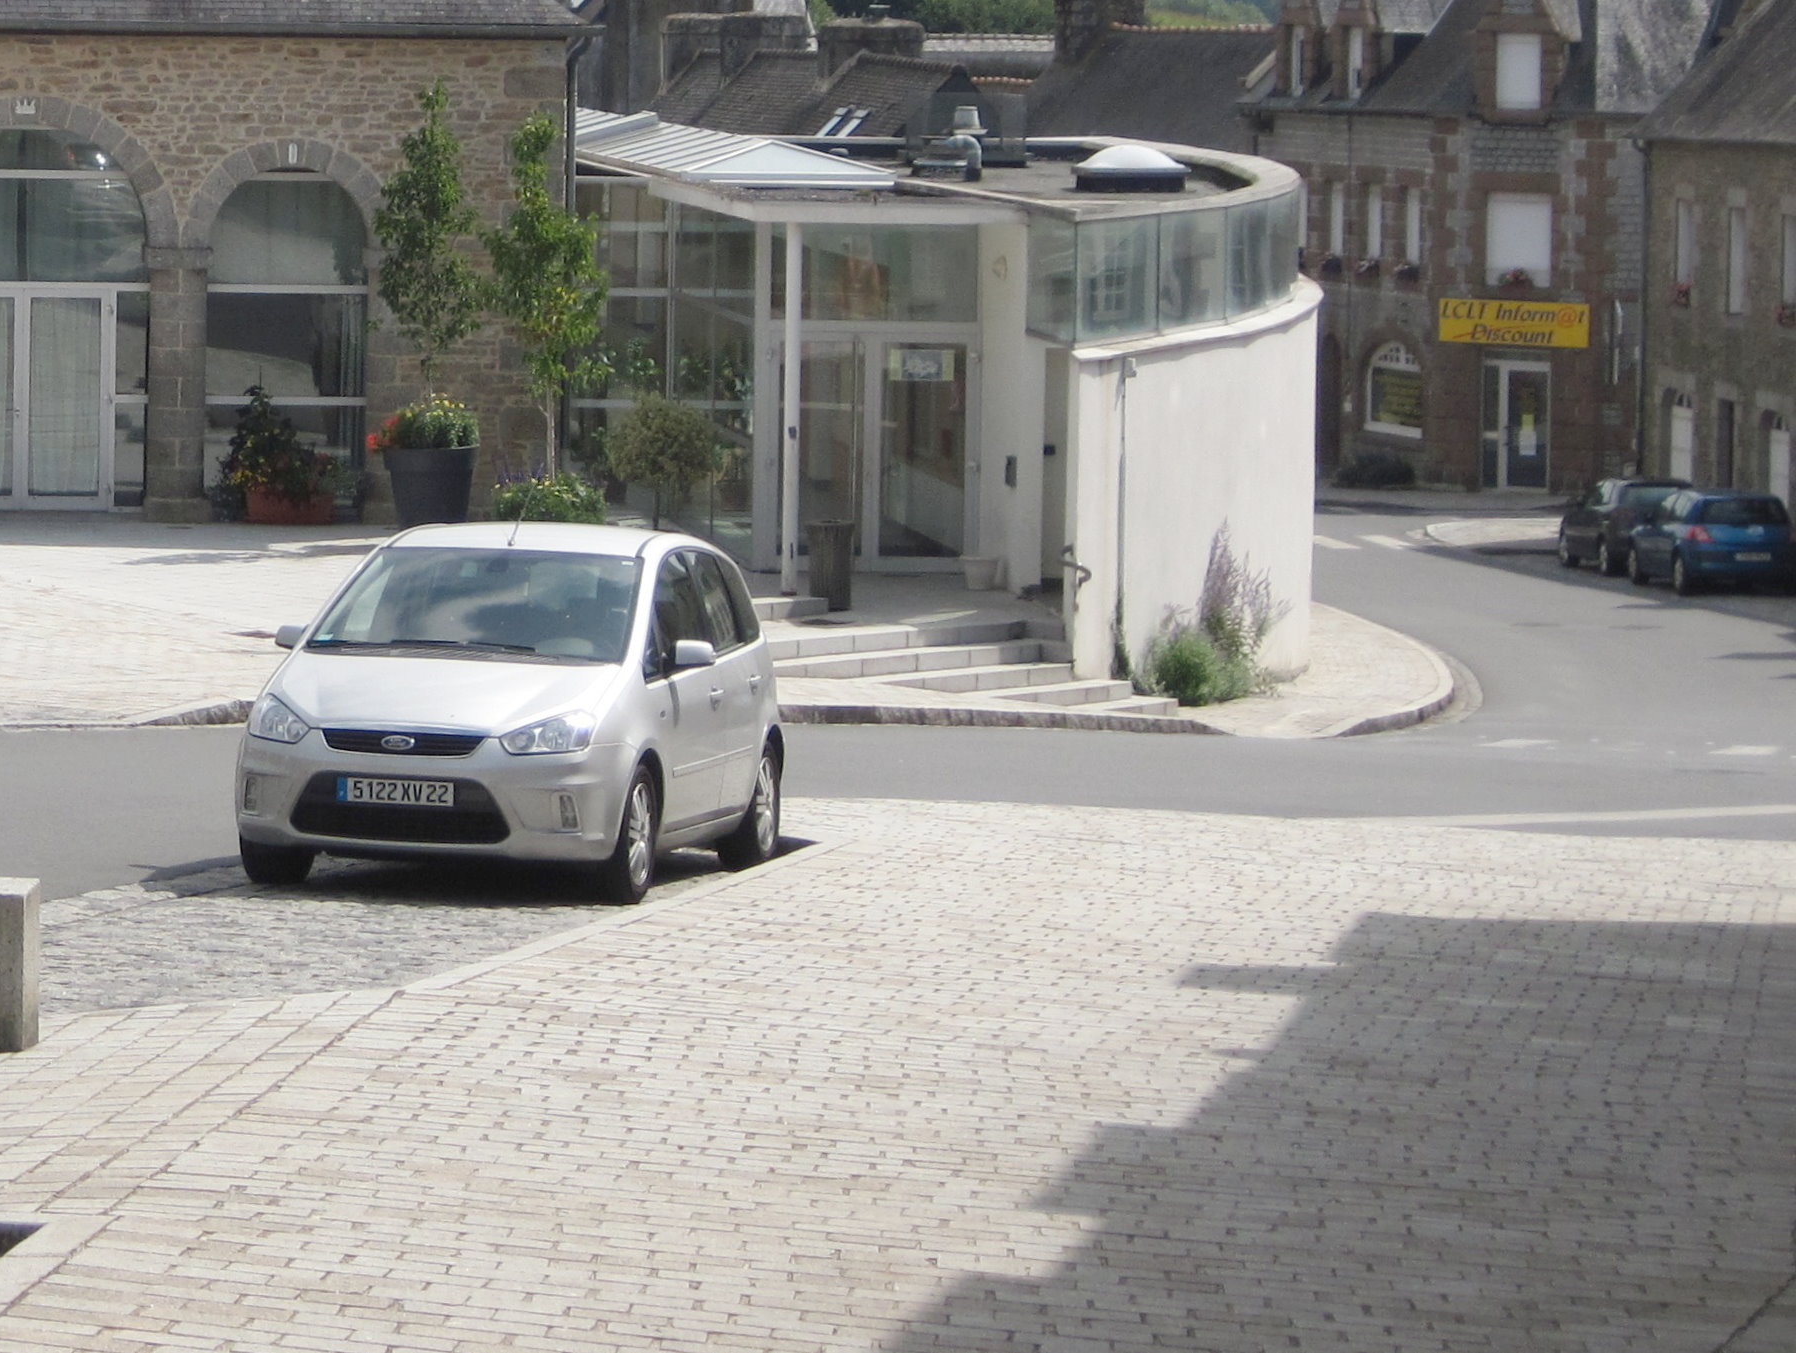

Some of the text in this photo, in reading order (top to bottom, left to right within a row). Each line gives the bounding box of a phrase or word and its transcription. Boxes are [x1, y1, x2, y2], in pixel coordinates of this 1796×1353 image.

[1441, 300, 1586, 329] LCLT Inform@t
[1471, 322, 1553, 344] Discount
[353, 779, 449, 804] 5122 XV 22
